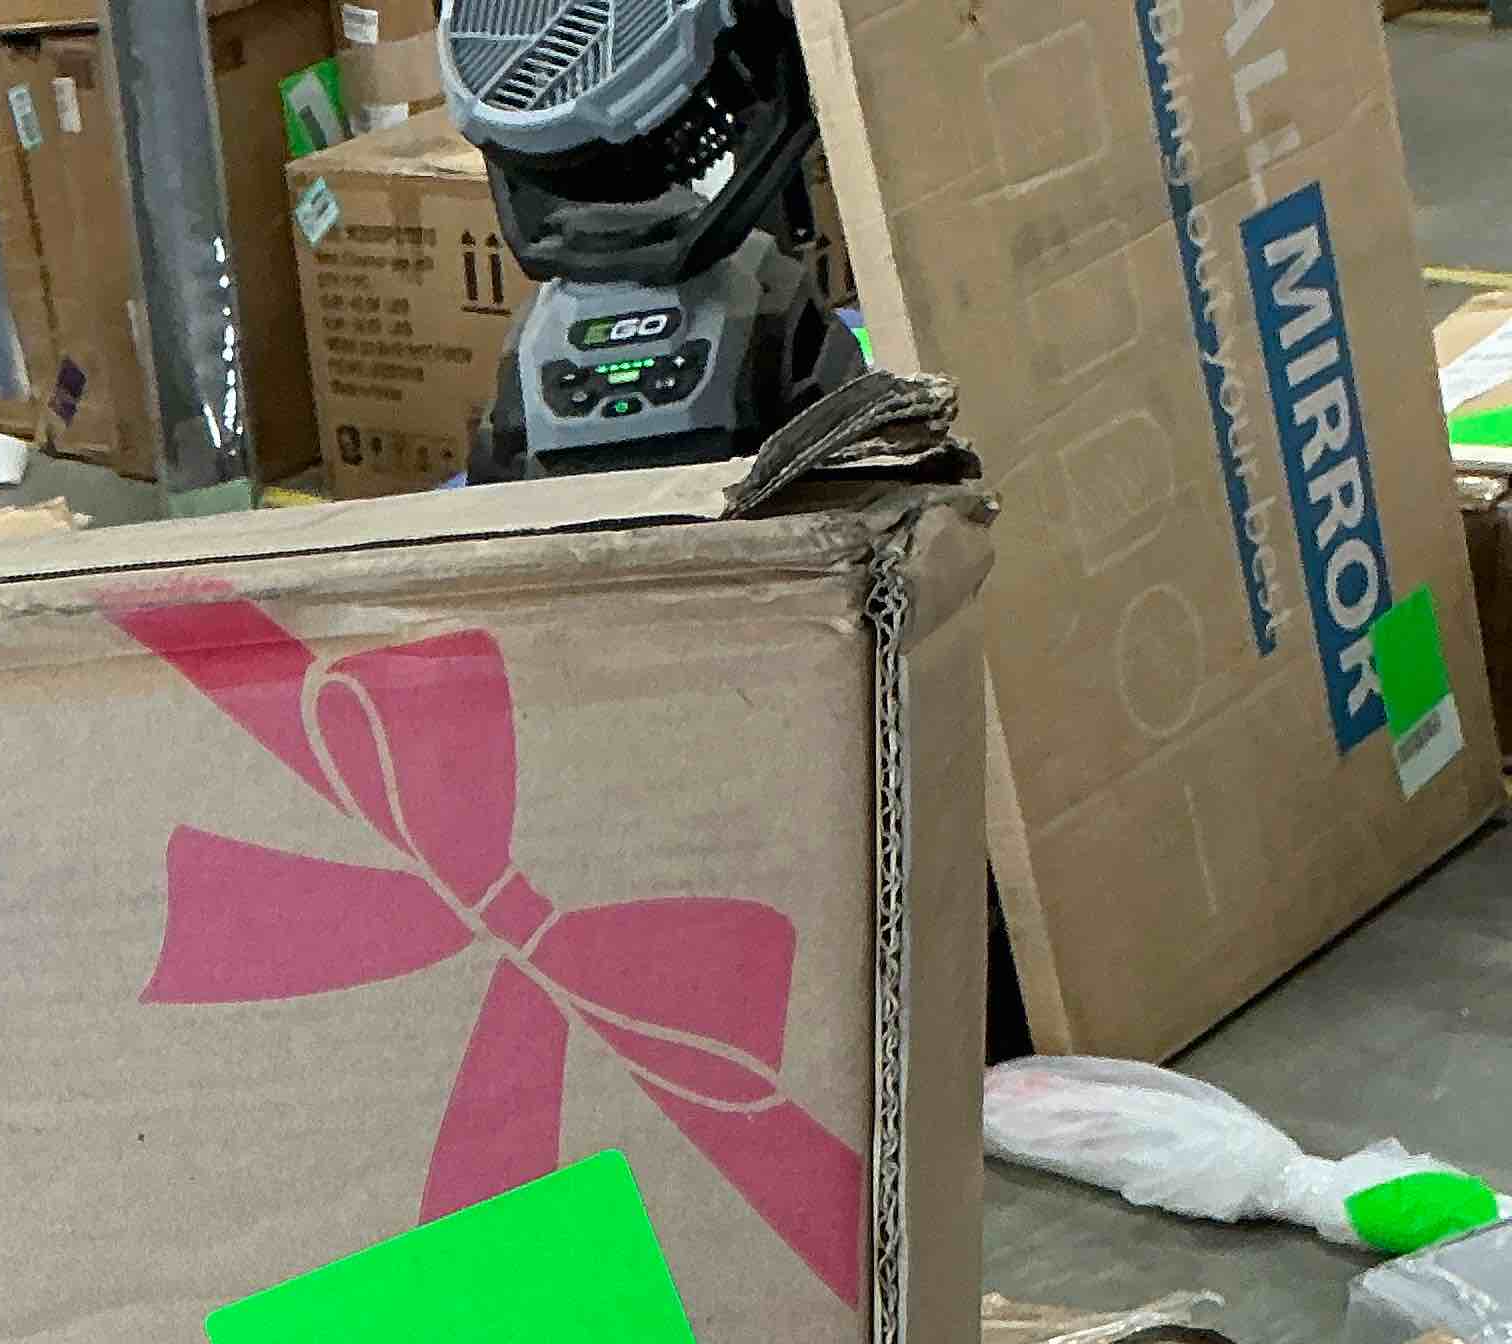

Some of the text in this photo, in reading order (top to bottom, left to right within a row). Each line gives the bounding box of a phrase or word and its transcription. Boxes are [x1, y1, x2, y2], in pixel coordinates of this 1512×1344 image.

[584, 314, 668, 345] EGO
[1188, 205, 1236, 336] out
[1201, 328, 1259, 483] your
